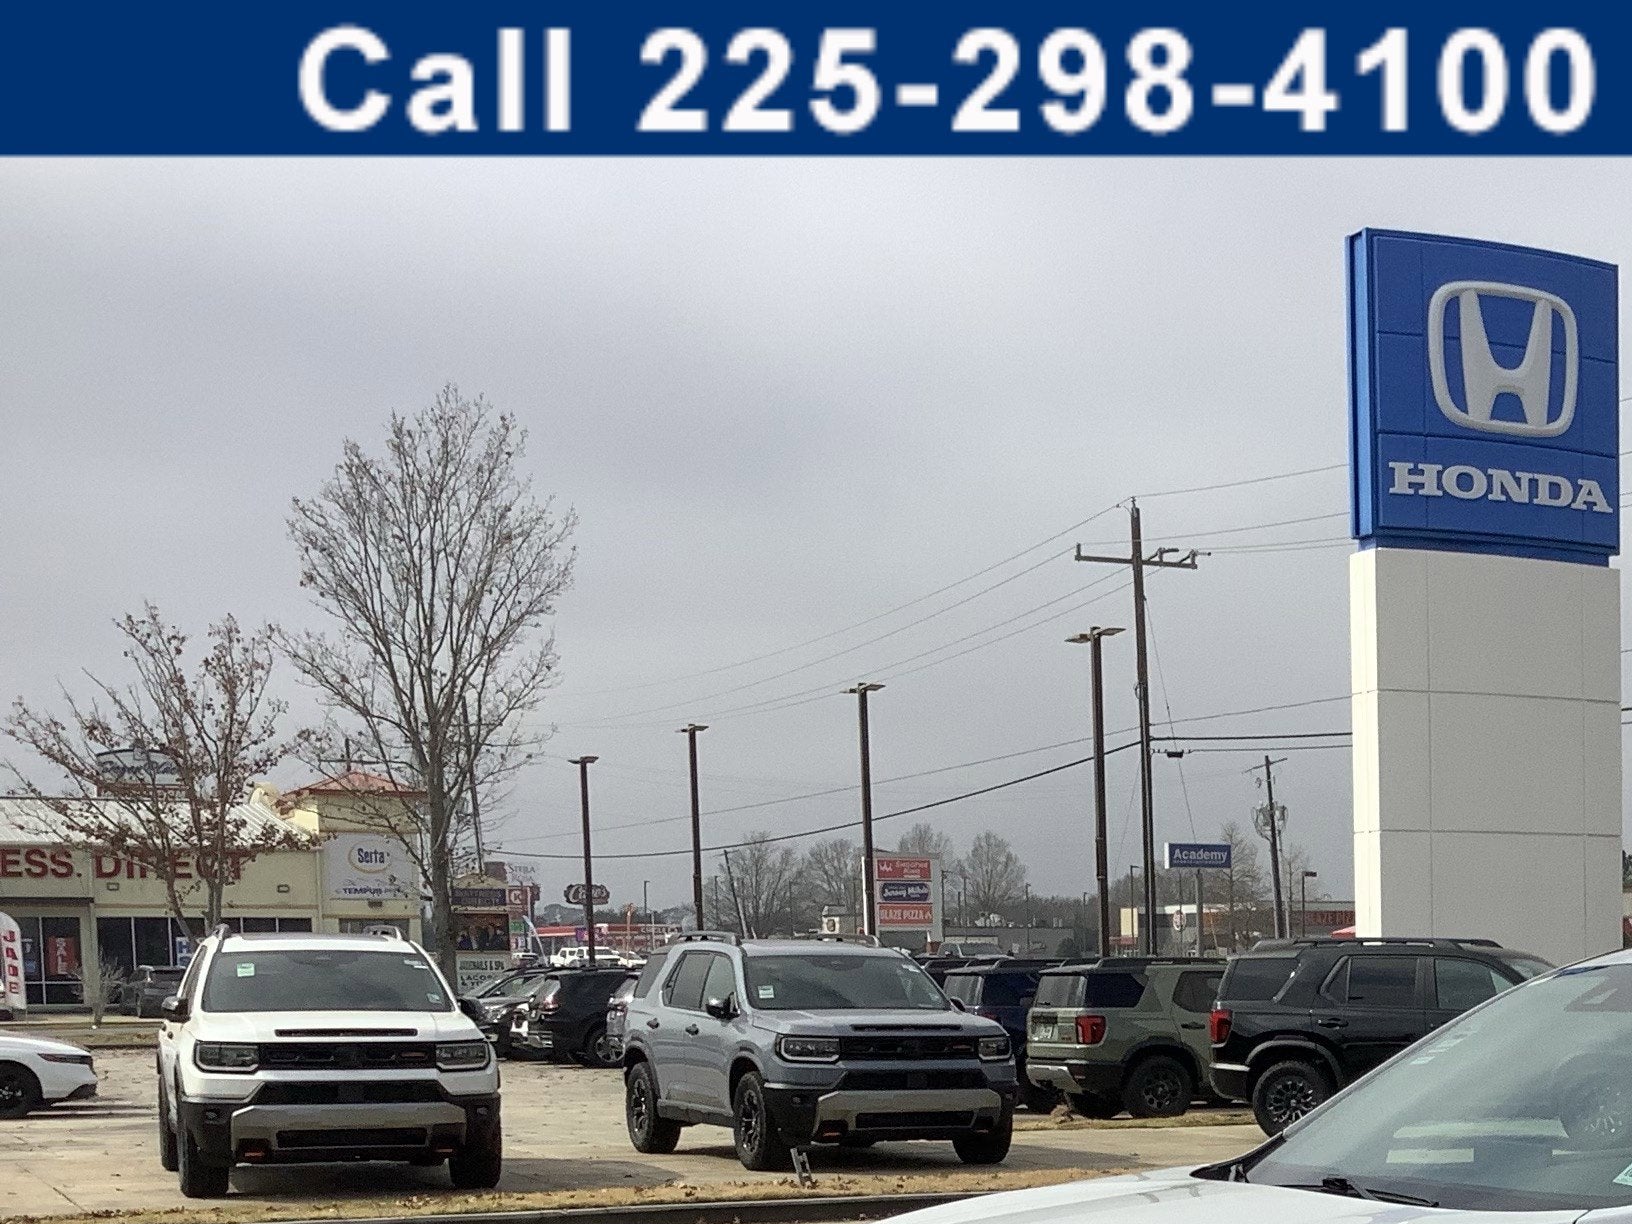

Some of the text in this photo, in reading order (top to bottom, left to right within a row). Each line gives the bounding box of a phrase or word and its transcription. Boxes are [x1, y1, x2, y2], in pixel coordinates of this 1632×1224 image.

[1388, 461, 1614, 514] HONDA
[357, 848, 385, 864] Serta
[1173, 848, 1228, 863] Academy
